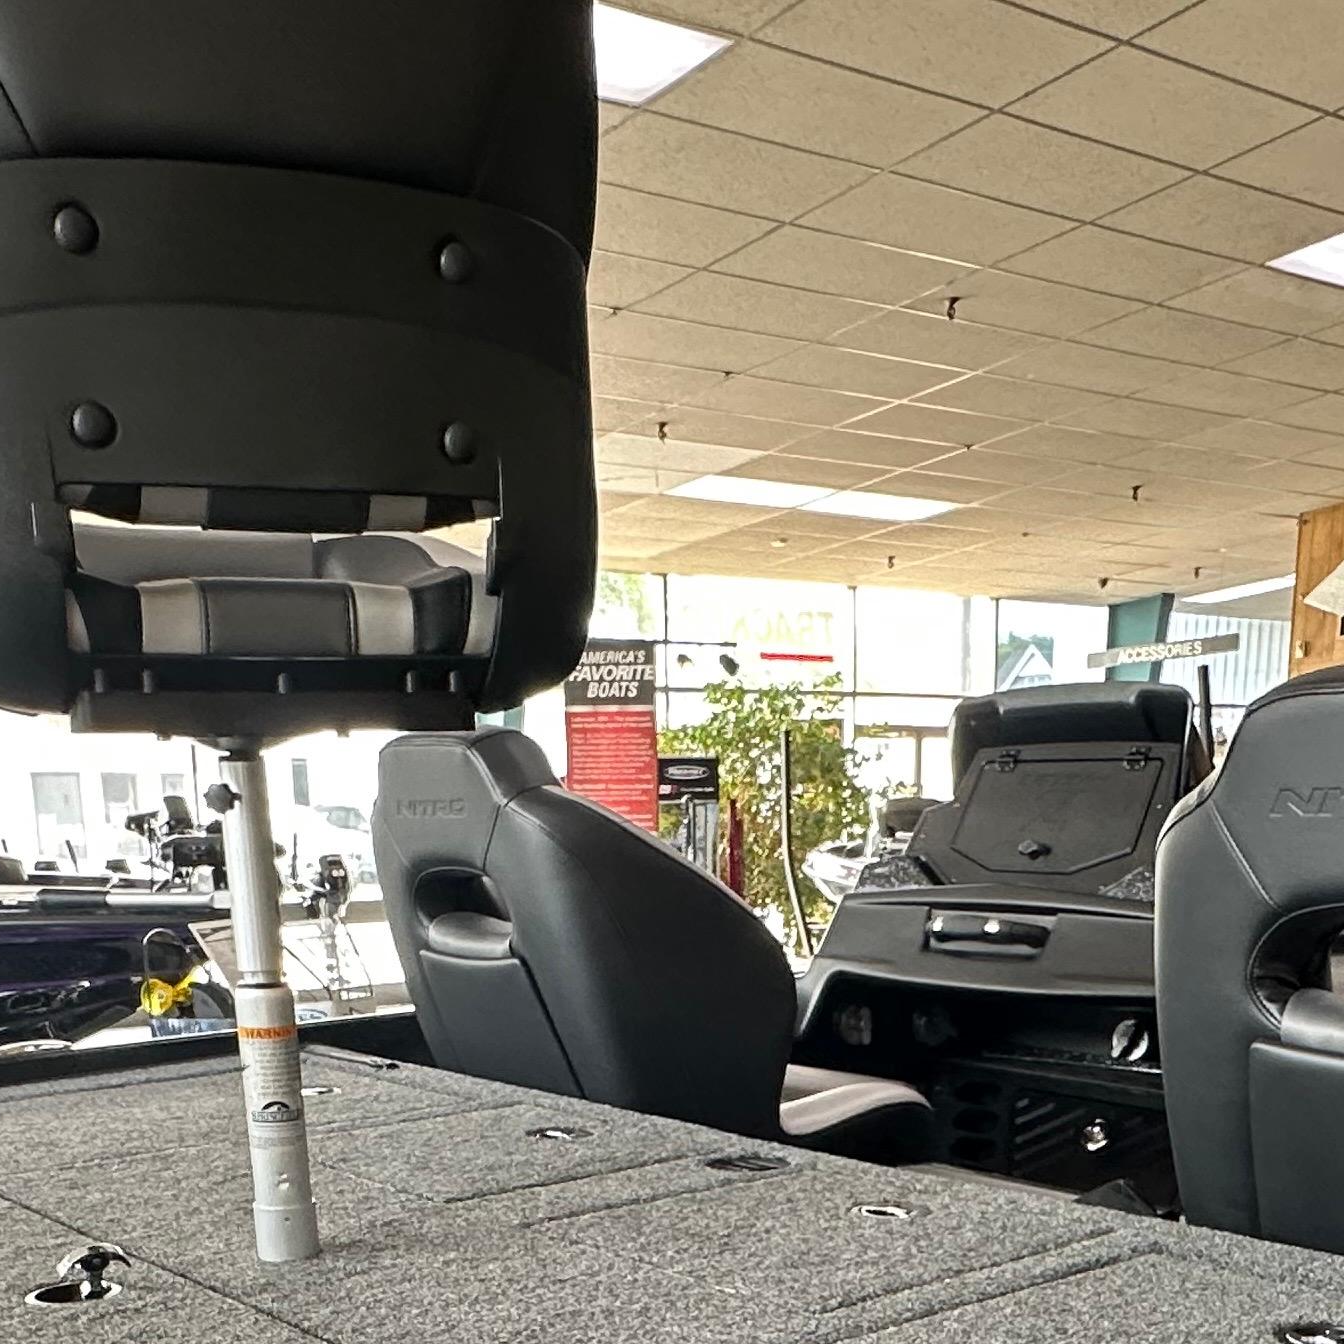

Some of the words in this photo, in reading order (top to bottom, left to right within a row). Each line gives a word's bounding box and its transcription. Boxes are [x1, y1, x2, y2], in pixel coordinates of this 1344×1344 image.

[579, 650, 646, 665] AMERICA'S
[1116, 641, 1203, 664] ACCESSORIES
[568, 664, 655, 682] FAVORITE
[586, 681, 639, 698] BOATS
[396, 798, 468, 819] NITRO
